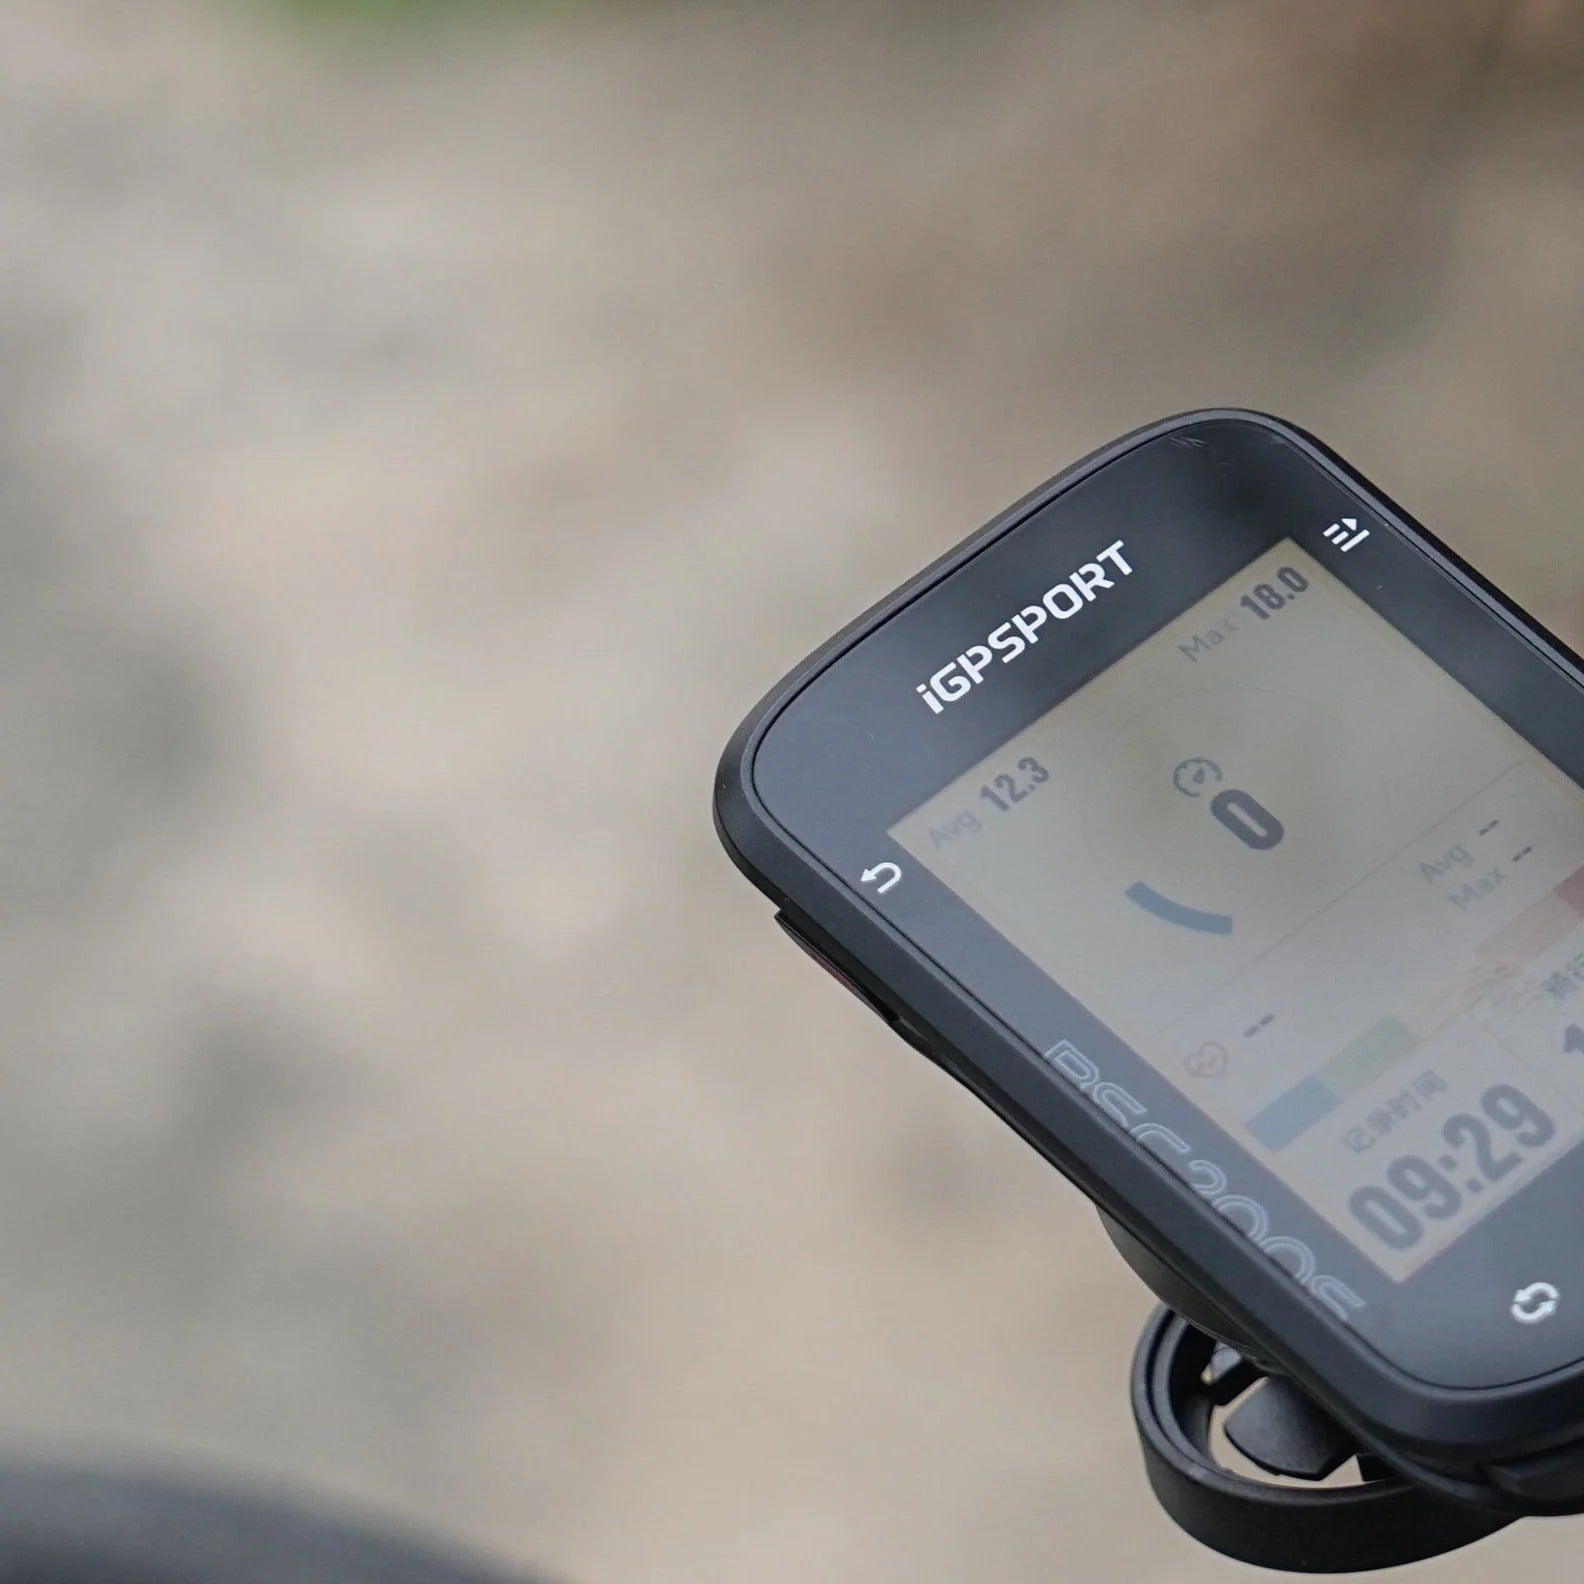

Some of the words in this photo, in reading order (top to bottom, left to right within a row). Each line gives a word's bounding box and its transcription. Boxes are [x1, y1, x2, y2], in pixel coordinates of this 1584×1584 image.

[1240, 566, 1309, 620] 18.0
[917, 540, 1133, 714] iGPSPORT
[928, 808, 983, 849] Avg
[980, 756, 1050, 811] 12.3
[1211, 789, 1285, 850] 0
[1419, 844, 1474, 884] Avg
[1447, 867, 1509, 910] Max
[1348, 1084, 1556, 1251] 09:29
